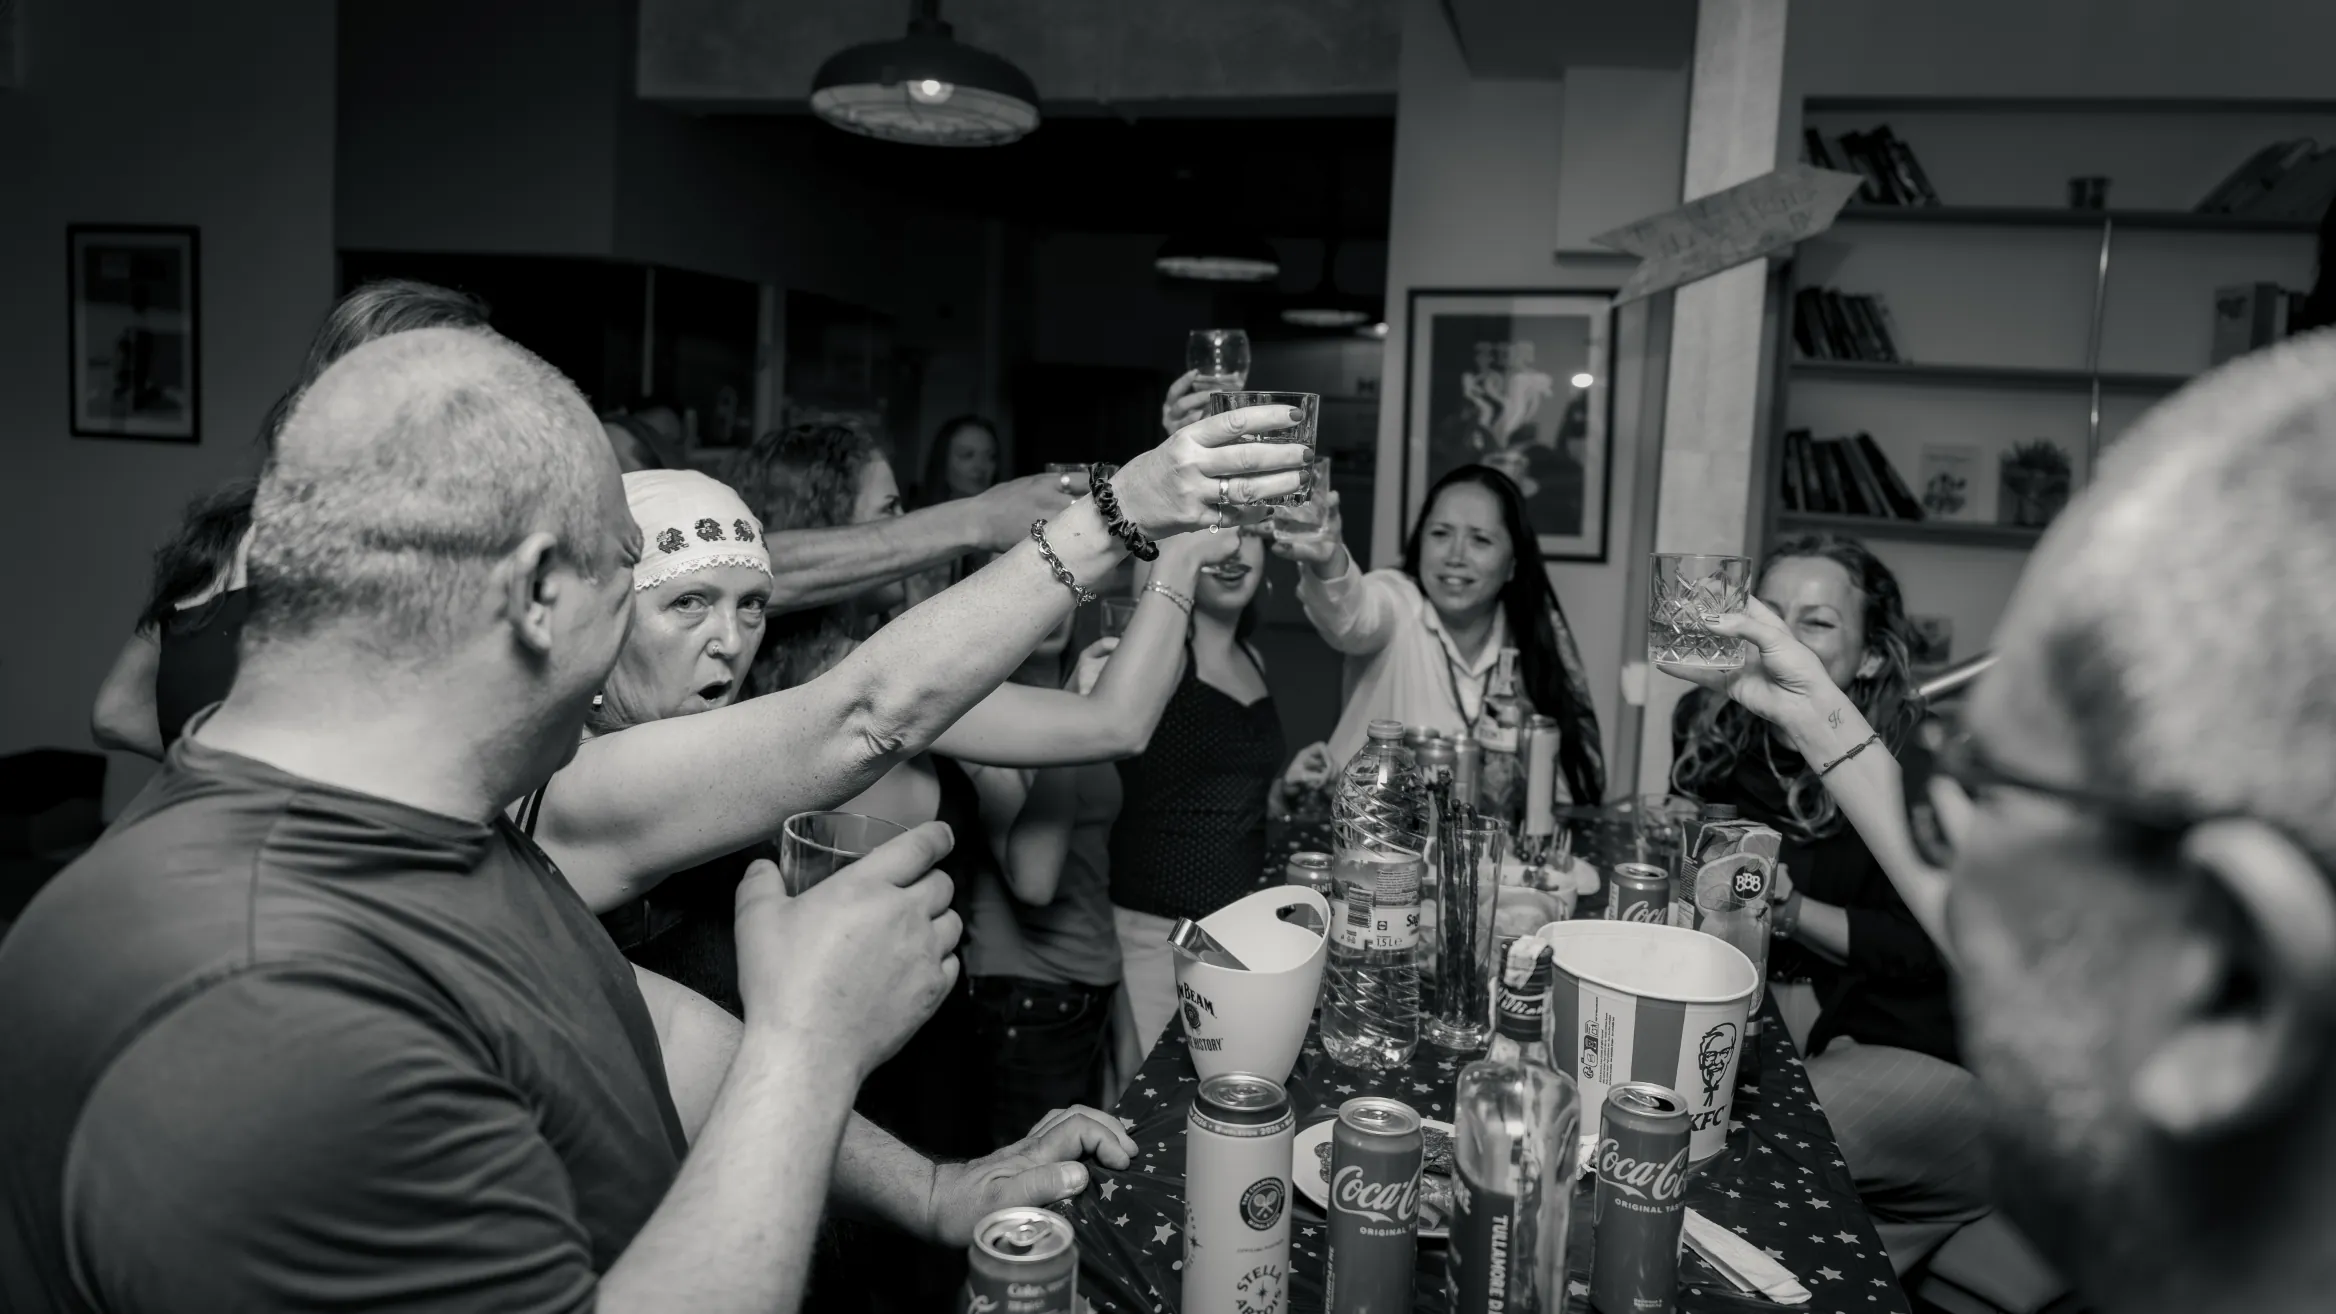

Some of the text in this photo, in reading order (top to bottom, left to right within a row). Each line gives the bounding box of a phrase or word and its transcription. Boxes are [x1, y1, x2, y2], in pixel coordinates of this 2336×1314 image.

[1735, 872, 1761, 892] BBB
[1183, 981, 1215, 1017] BEAM
[1193, 1037, 1222, 1051] HISTORY
[1689, 1104, 1728, 1131] KFC
[1615, 1198, 1663, 1213] ORIGINAL
[1359, 1226, 1407, 1237] ORIGINAL
[1489, 1215, 1509, 1299] TULLAMORE
[1237, 1264, 1282, 1292] STELLA
